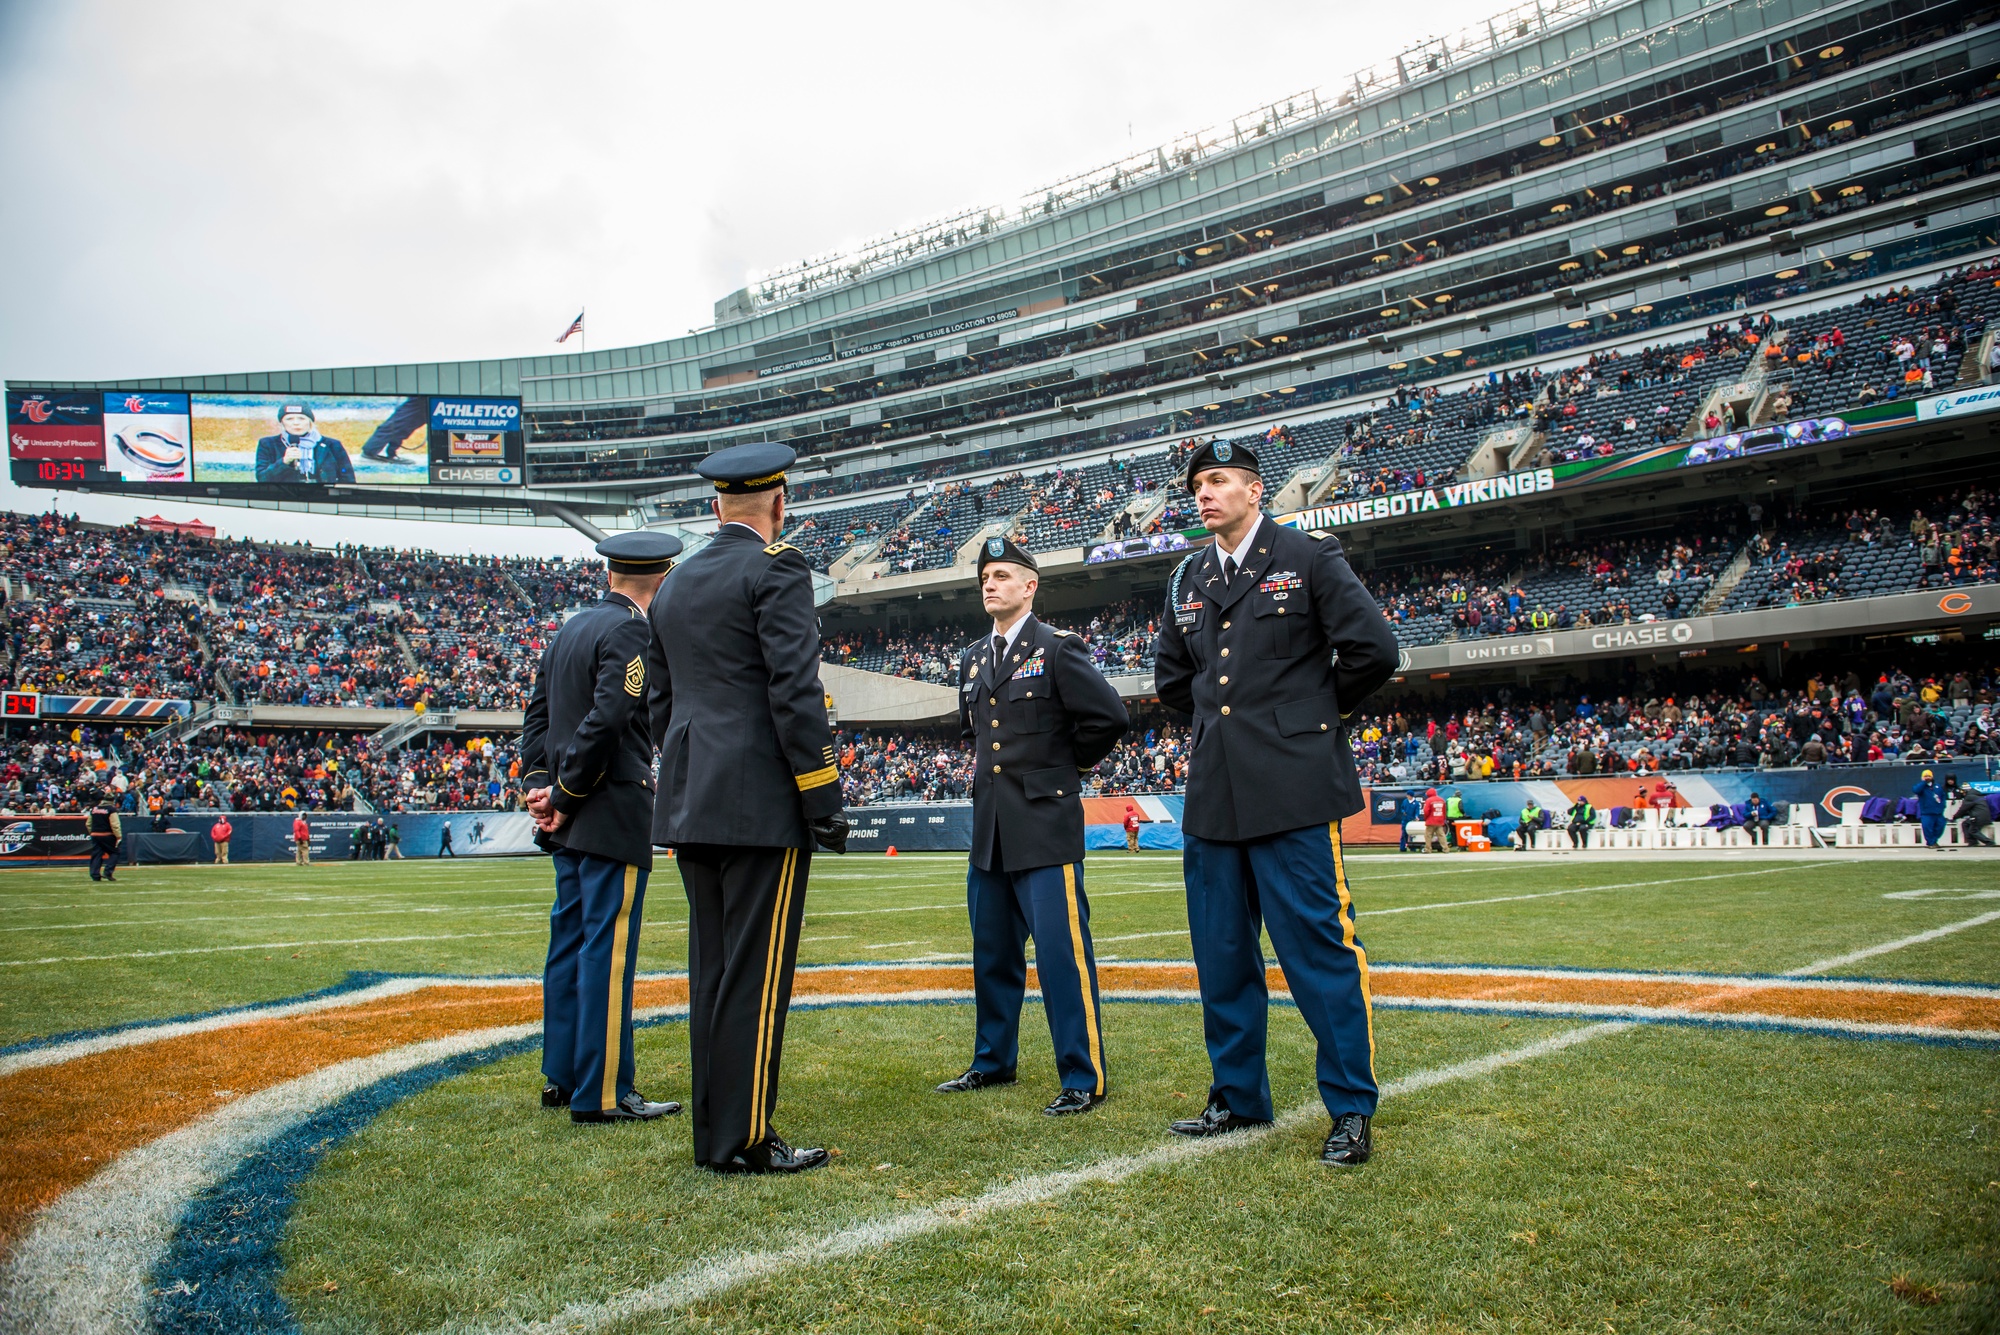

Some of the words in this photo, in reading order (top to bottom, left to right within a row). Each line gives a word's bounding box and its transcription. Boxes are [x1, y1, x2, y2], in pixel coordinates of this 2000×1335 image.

[841, 350, 857, 359] TEXT
[912, 332, 926, 342] THE
[926, 328, 946, 339] ISSUE
[951, 318, 985, 332] LOCATION
[987, 314, 996, 323] TO
[997, 309, 1017, 321] 69050
[1721, 387, 1734, 398] 307
[1747, 381, 1760, 392] 308
[1955, 390, 2000, 406] BOEIN
[20, 400, 53, 423] RC
[433, 401, 519, 418] ATHLETICO
[443, 418, 476, 426] PHYSICAL
[477, 418, 509, 427] THERAPY
[30, 439, 63, 448] University
[63, 439, 71, 447] of
[71, 439, 97, 447] Phoenix
[455, 441, 473, 449] TRUCK
[474, 441, 499, 450] CENTERS
[39, 462, 85, 480] 10:34
[438, 468, 495, 481] CHASE
[1296, 490, 1440, 531] MINNESOTA
[1444, 468, 1554, 507] VIKINGS
[1591, 626, 1668, 649] CHASE
[1466, 643, 1533, 660] UNITED
[6, 694, 35, 715] 34
[219, 710, 231, 718] 153
[41, 833, 92, 842] usafootball.c
